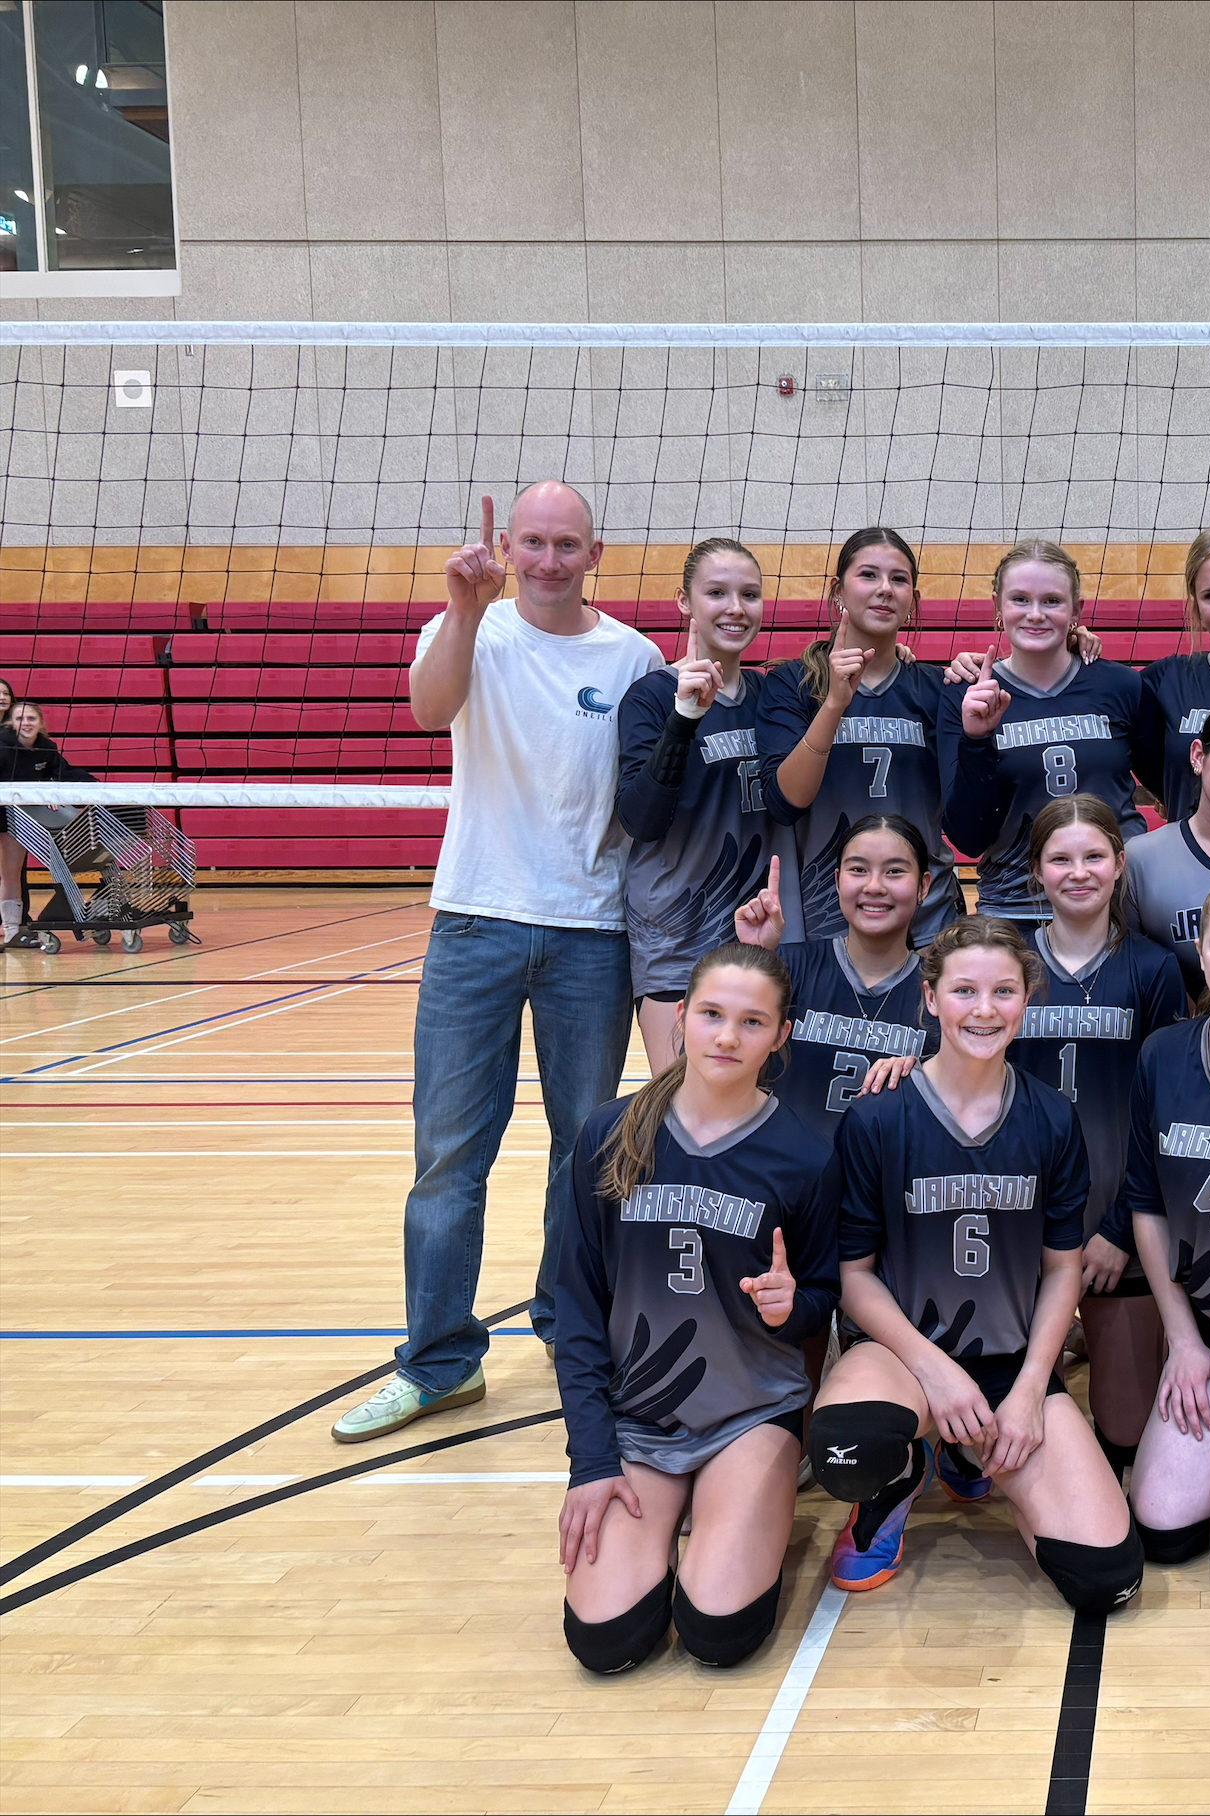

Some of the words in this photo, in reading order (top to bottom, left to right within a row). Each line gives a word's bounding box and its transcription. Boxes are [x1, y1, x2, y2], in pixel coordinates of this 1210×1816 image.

[700, 728, 759, 764] JACKS
[832, 716, 926, 747] ACKSON
[996, 714, 1112, 750] JACKSON
[863, 747, 892, 797] 7
[1042, 745, 1077, 797] 8
[792, 1009, 927, 1057] JACKSON
[825, 1051, 870, 1113] 2
[1058, 1043, 1077, 1102] 1
[620, 1184, 766, 1240] JACKSON
[905, 1174, 1037, 1214] JACKSON
[668, 1228, 705, 1295] 3
[953, 1214, 989, 1277] 6
